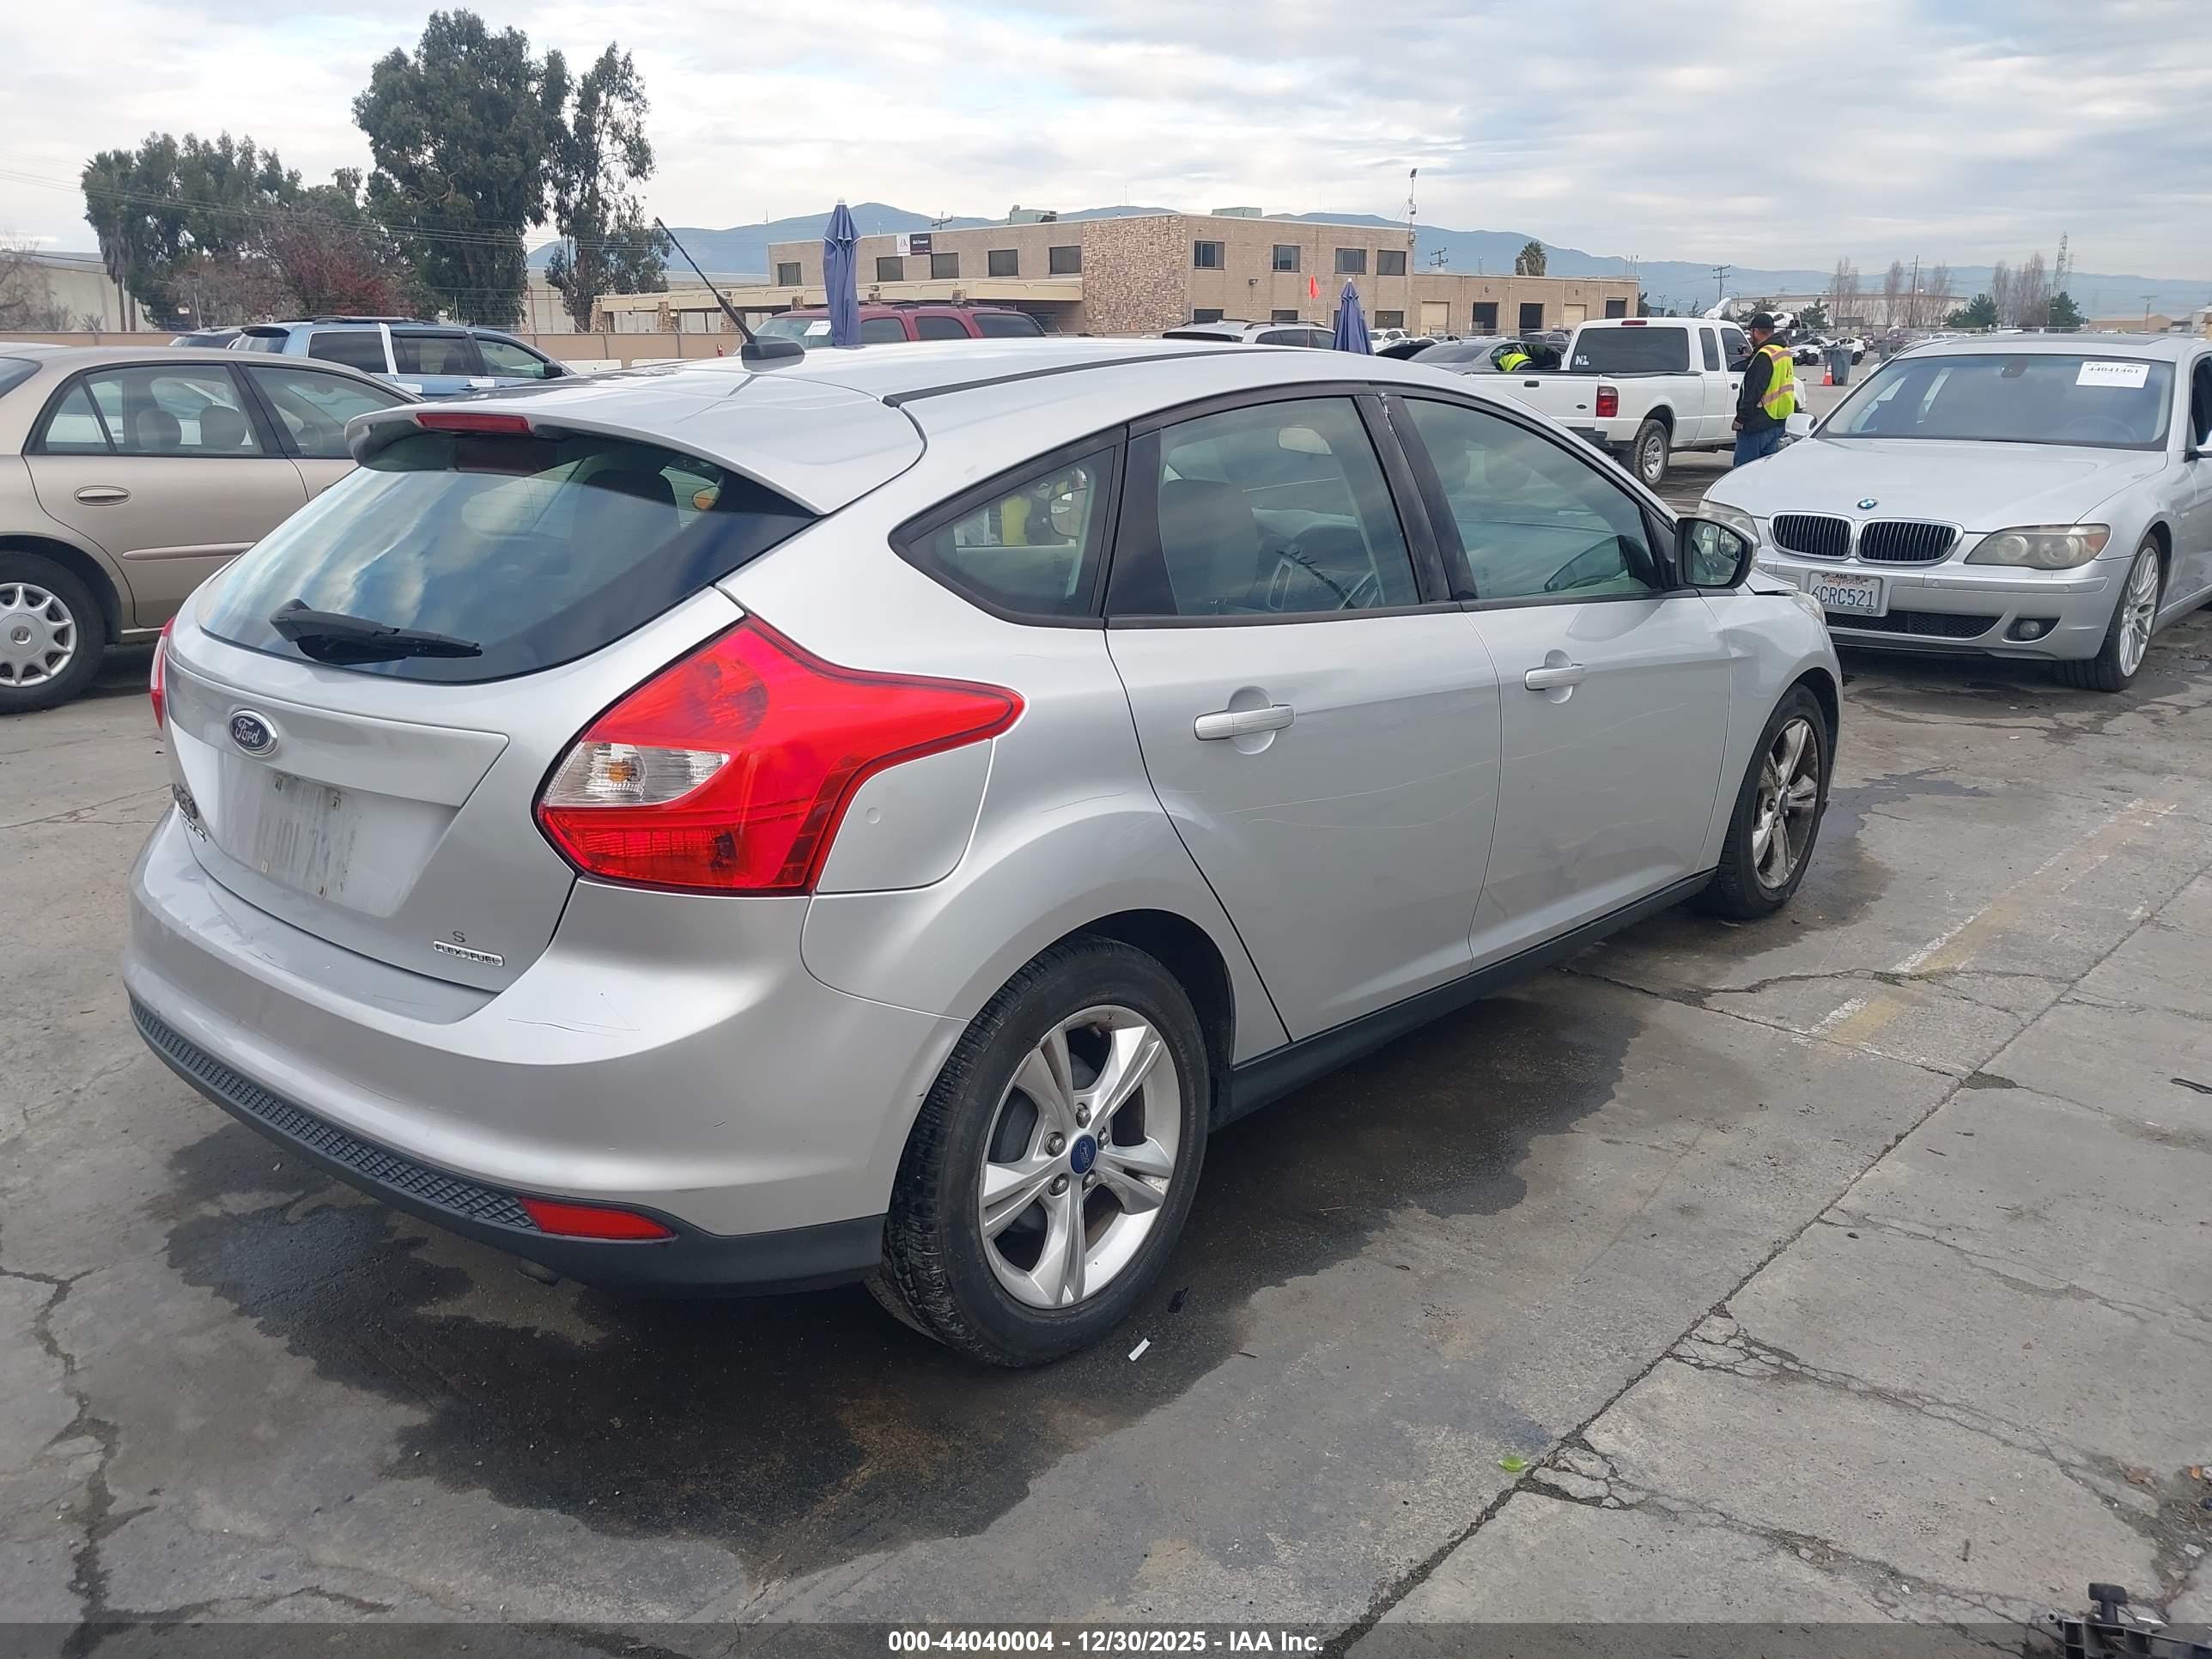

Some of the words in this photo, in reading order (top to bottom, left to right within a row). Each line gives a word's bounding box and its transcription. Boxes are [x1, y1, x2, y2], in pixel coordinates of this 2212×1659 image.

[1811, 585, 1875, 608] 6CRC521
[234, 717, 261, 744] Ford
[452, 930, 466, 943] S
[434, 943, 462, 957] FLEX
[470, 952, 501, 965] FUEL
